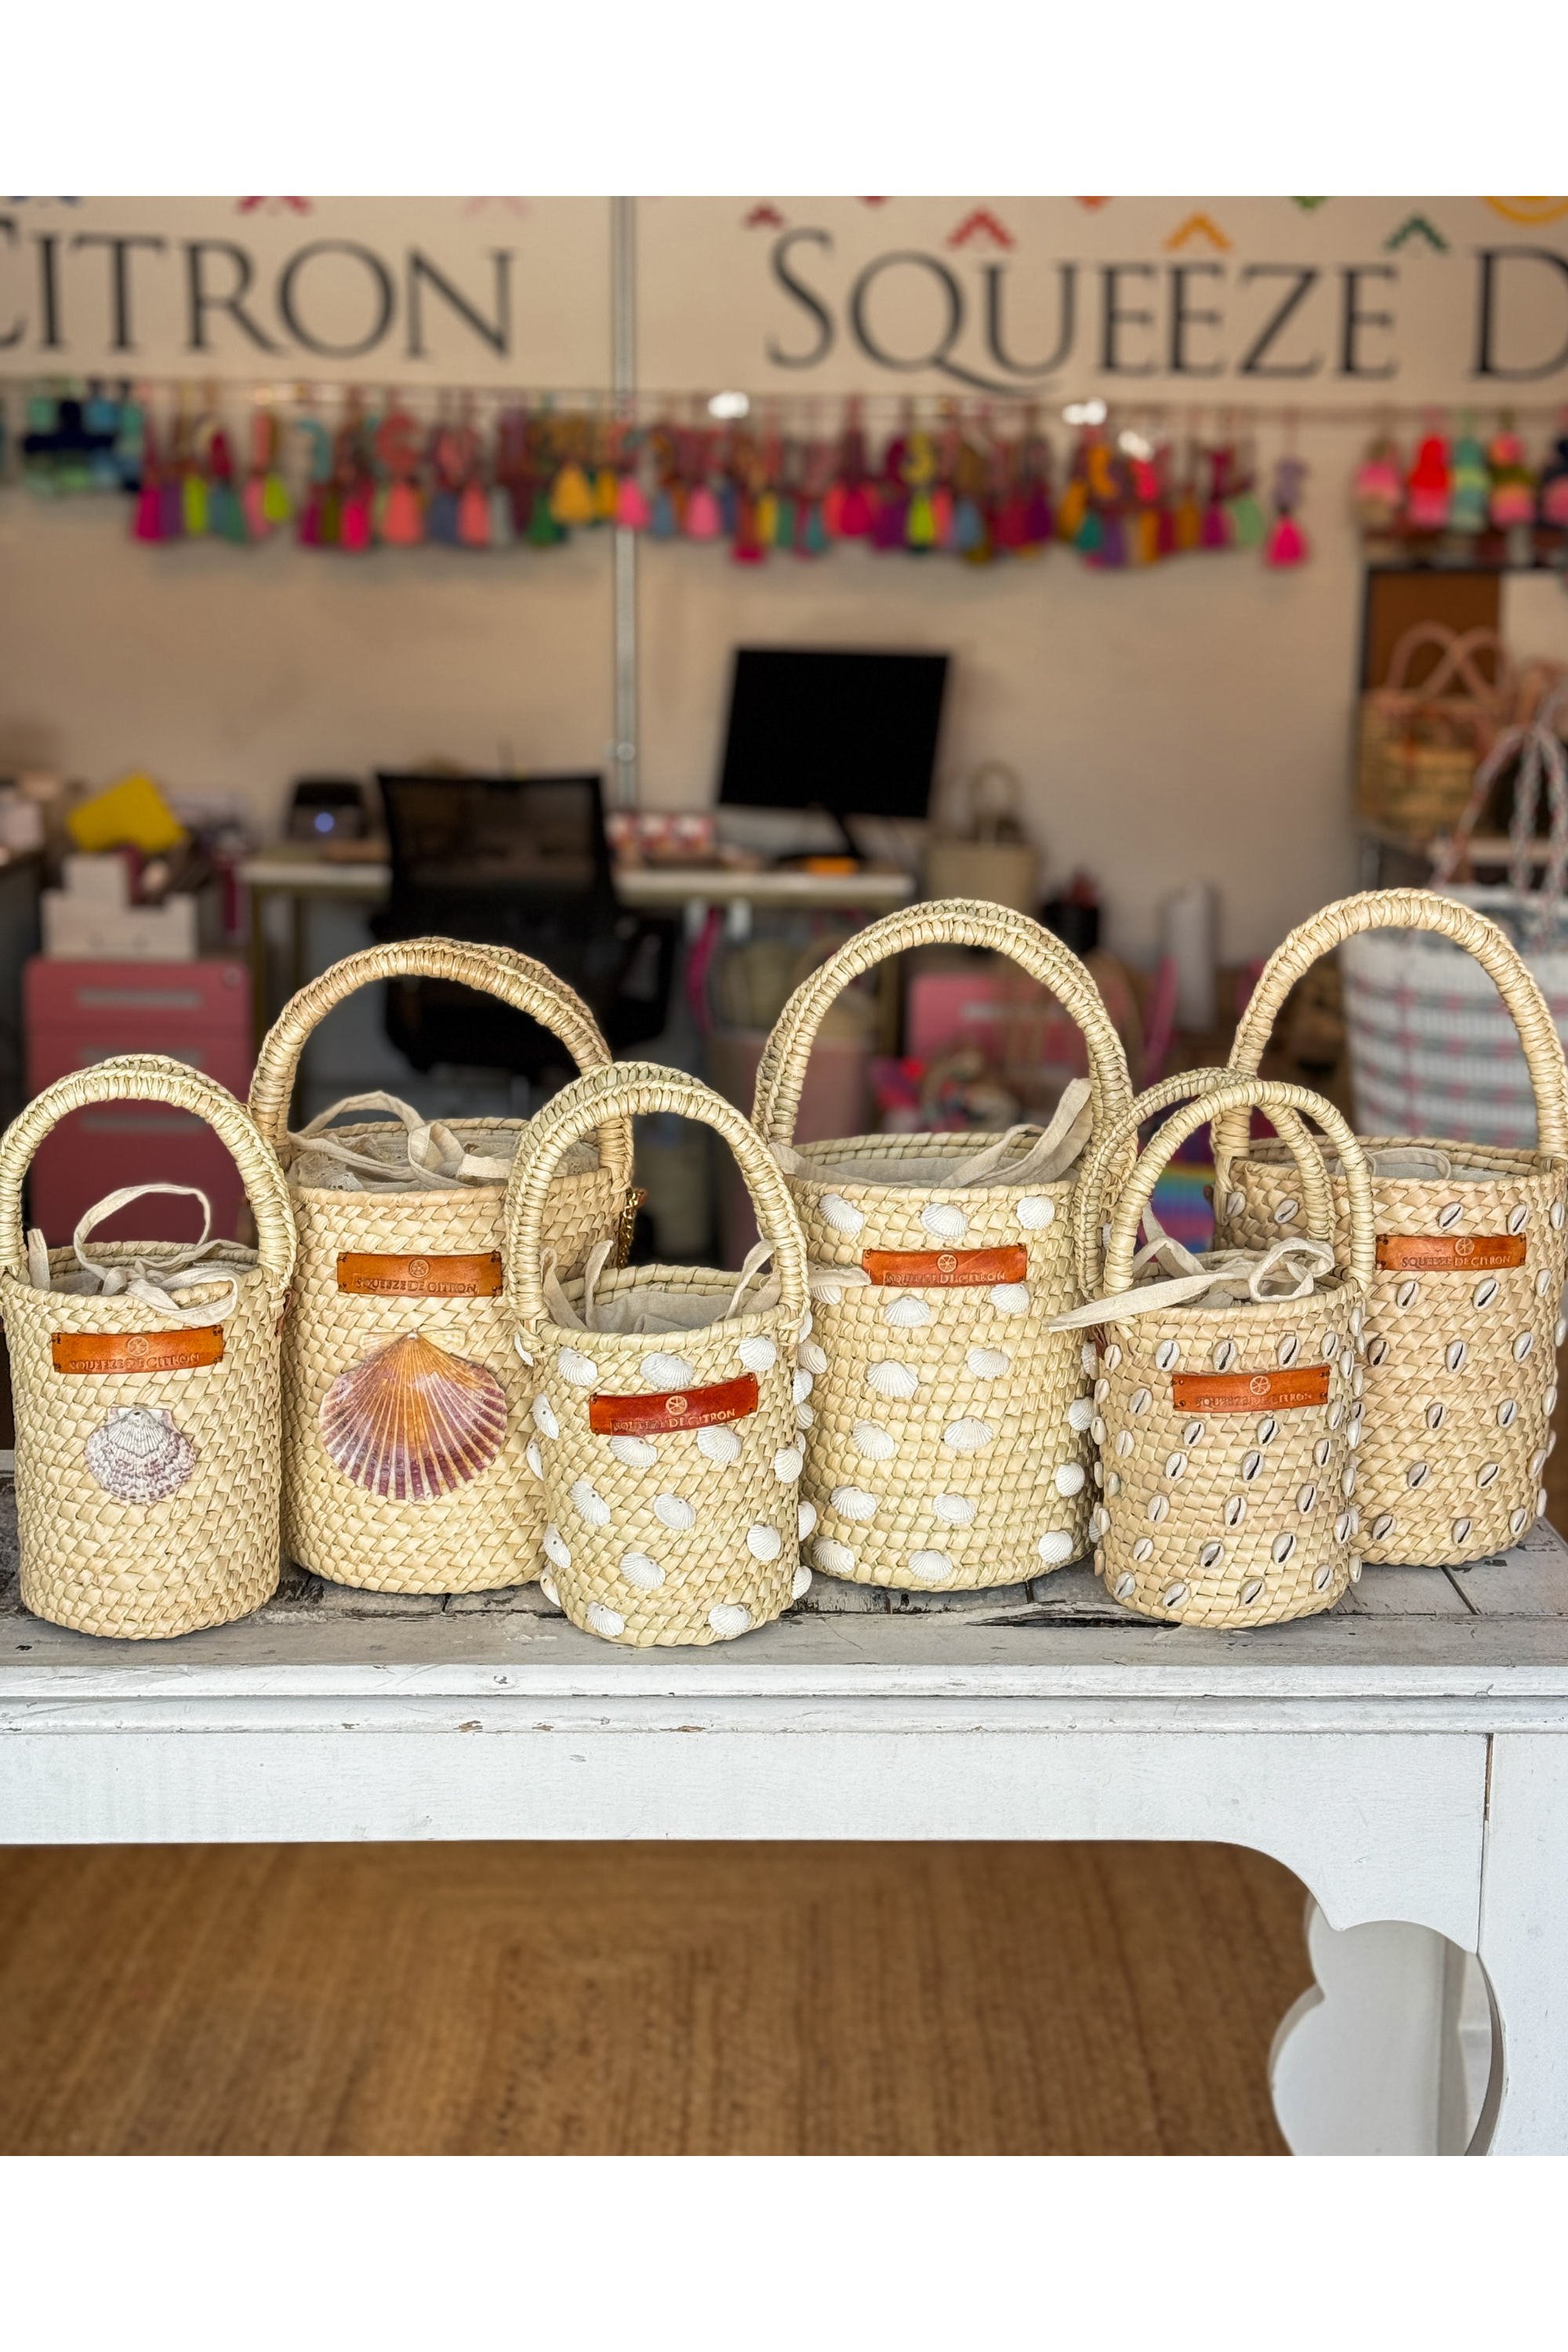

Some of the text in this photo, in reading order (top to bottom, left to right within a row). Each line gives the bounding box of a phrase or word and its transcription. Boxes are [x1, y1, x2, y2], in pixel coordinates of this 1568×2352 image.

[0, 215, 514, 360] ITRON
[766, 227, 1399, 397] SQUEEZE
[1471, 1255, 1511, 1267] CITRON
[355, 1278, 406, 1291] SQUEEZE
[427, 1282, 478, 1294] CITRON
[70, 1359, 124, 1372] SQUEEZE
[147, 1353, 200, 1369] CITRON
